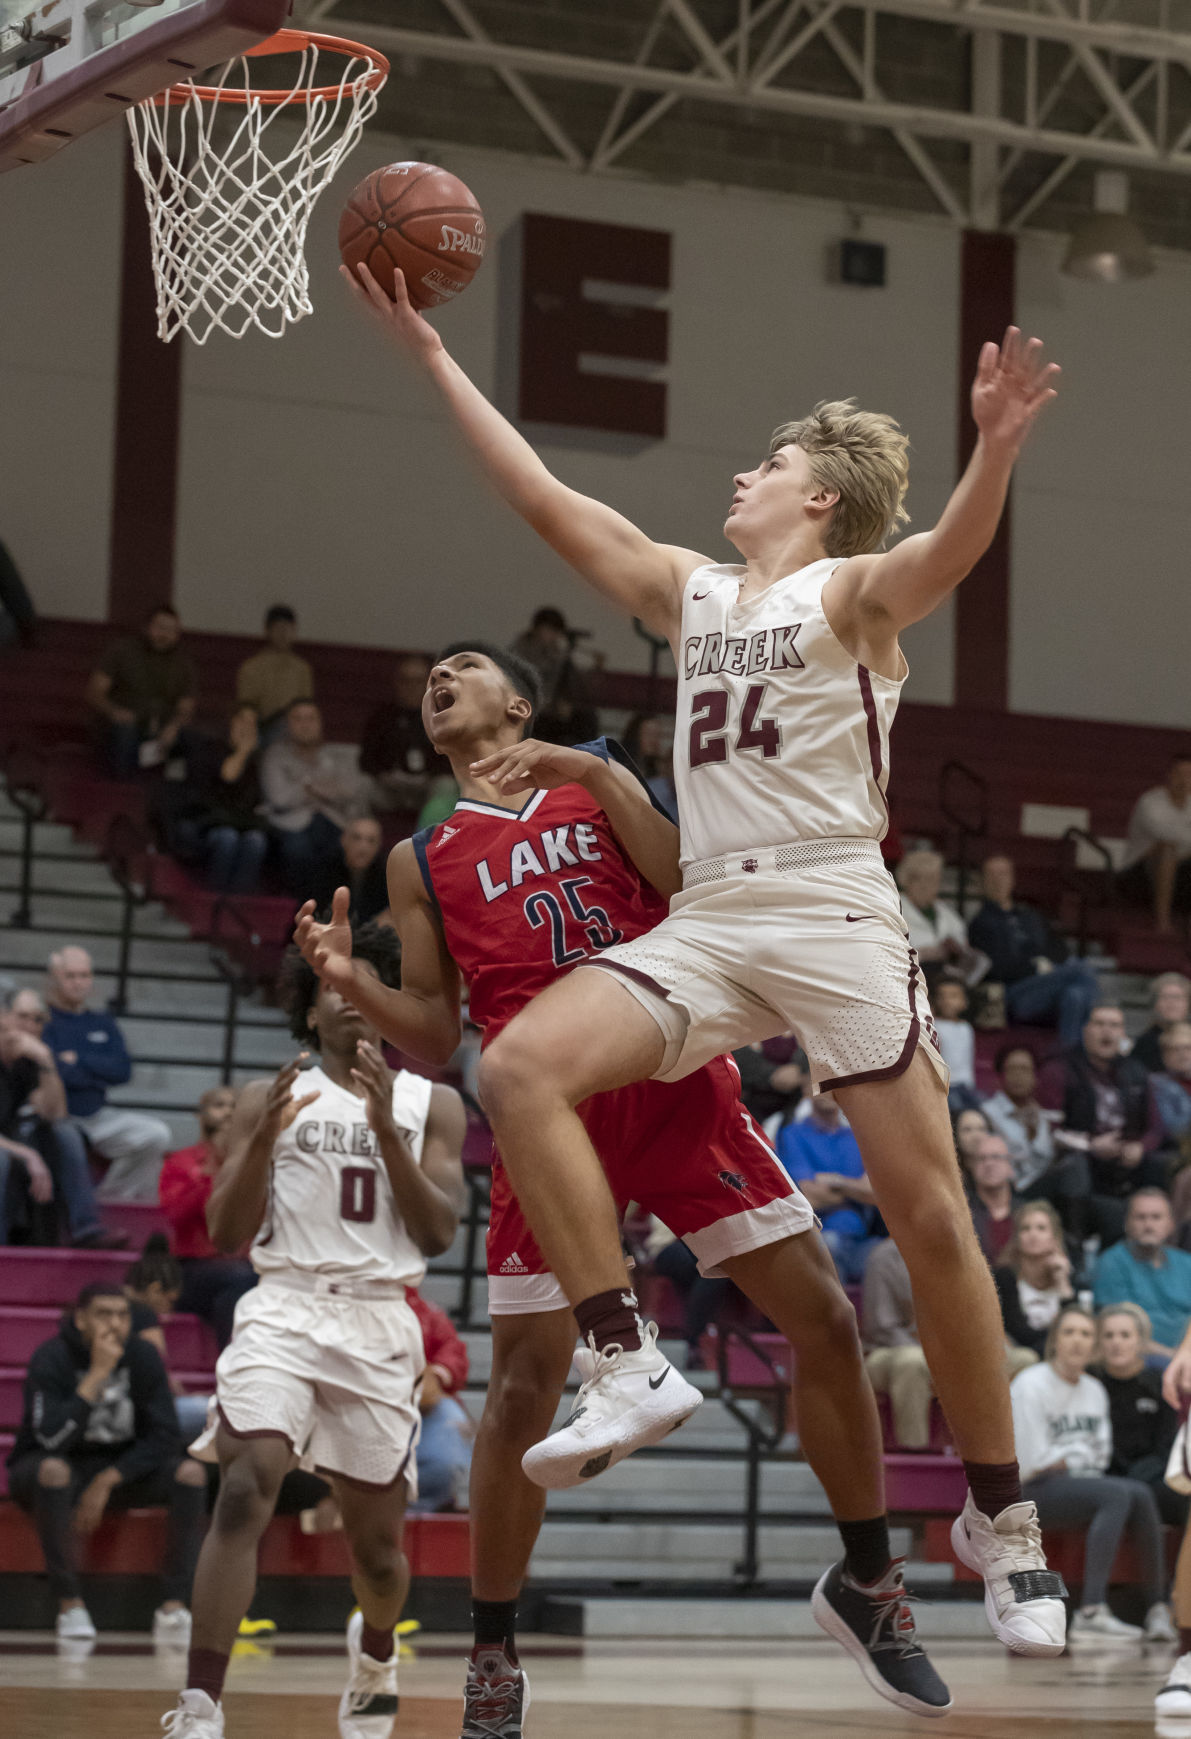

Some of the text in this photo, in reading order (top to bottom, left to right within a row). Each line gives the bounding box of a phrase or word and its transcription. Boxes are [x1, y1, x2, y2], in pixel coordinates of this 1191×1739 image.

[518, 210, 673, 441] E
[684, 623, 806, 681] CREEK
[688, 681, 784, 771] 24
[475, 822, 603, 904] LAKE
[523, 875, 624, 969] 25
[295, 1120, 418, 1158] CRE
[340, 1166, 377, 1224] 0
[499, 1265, 529, 1273] adidas
